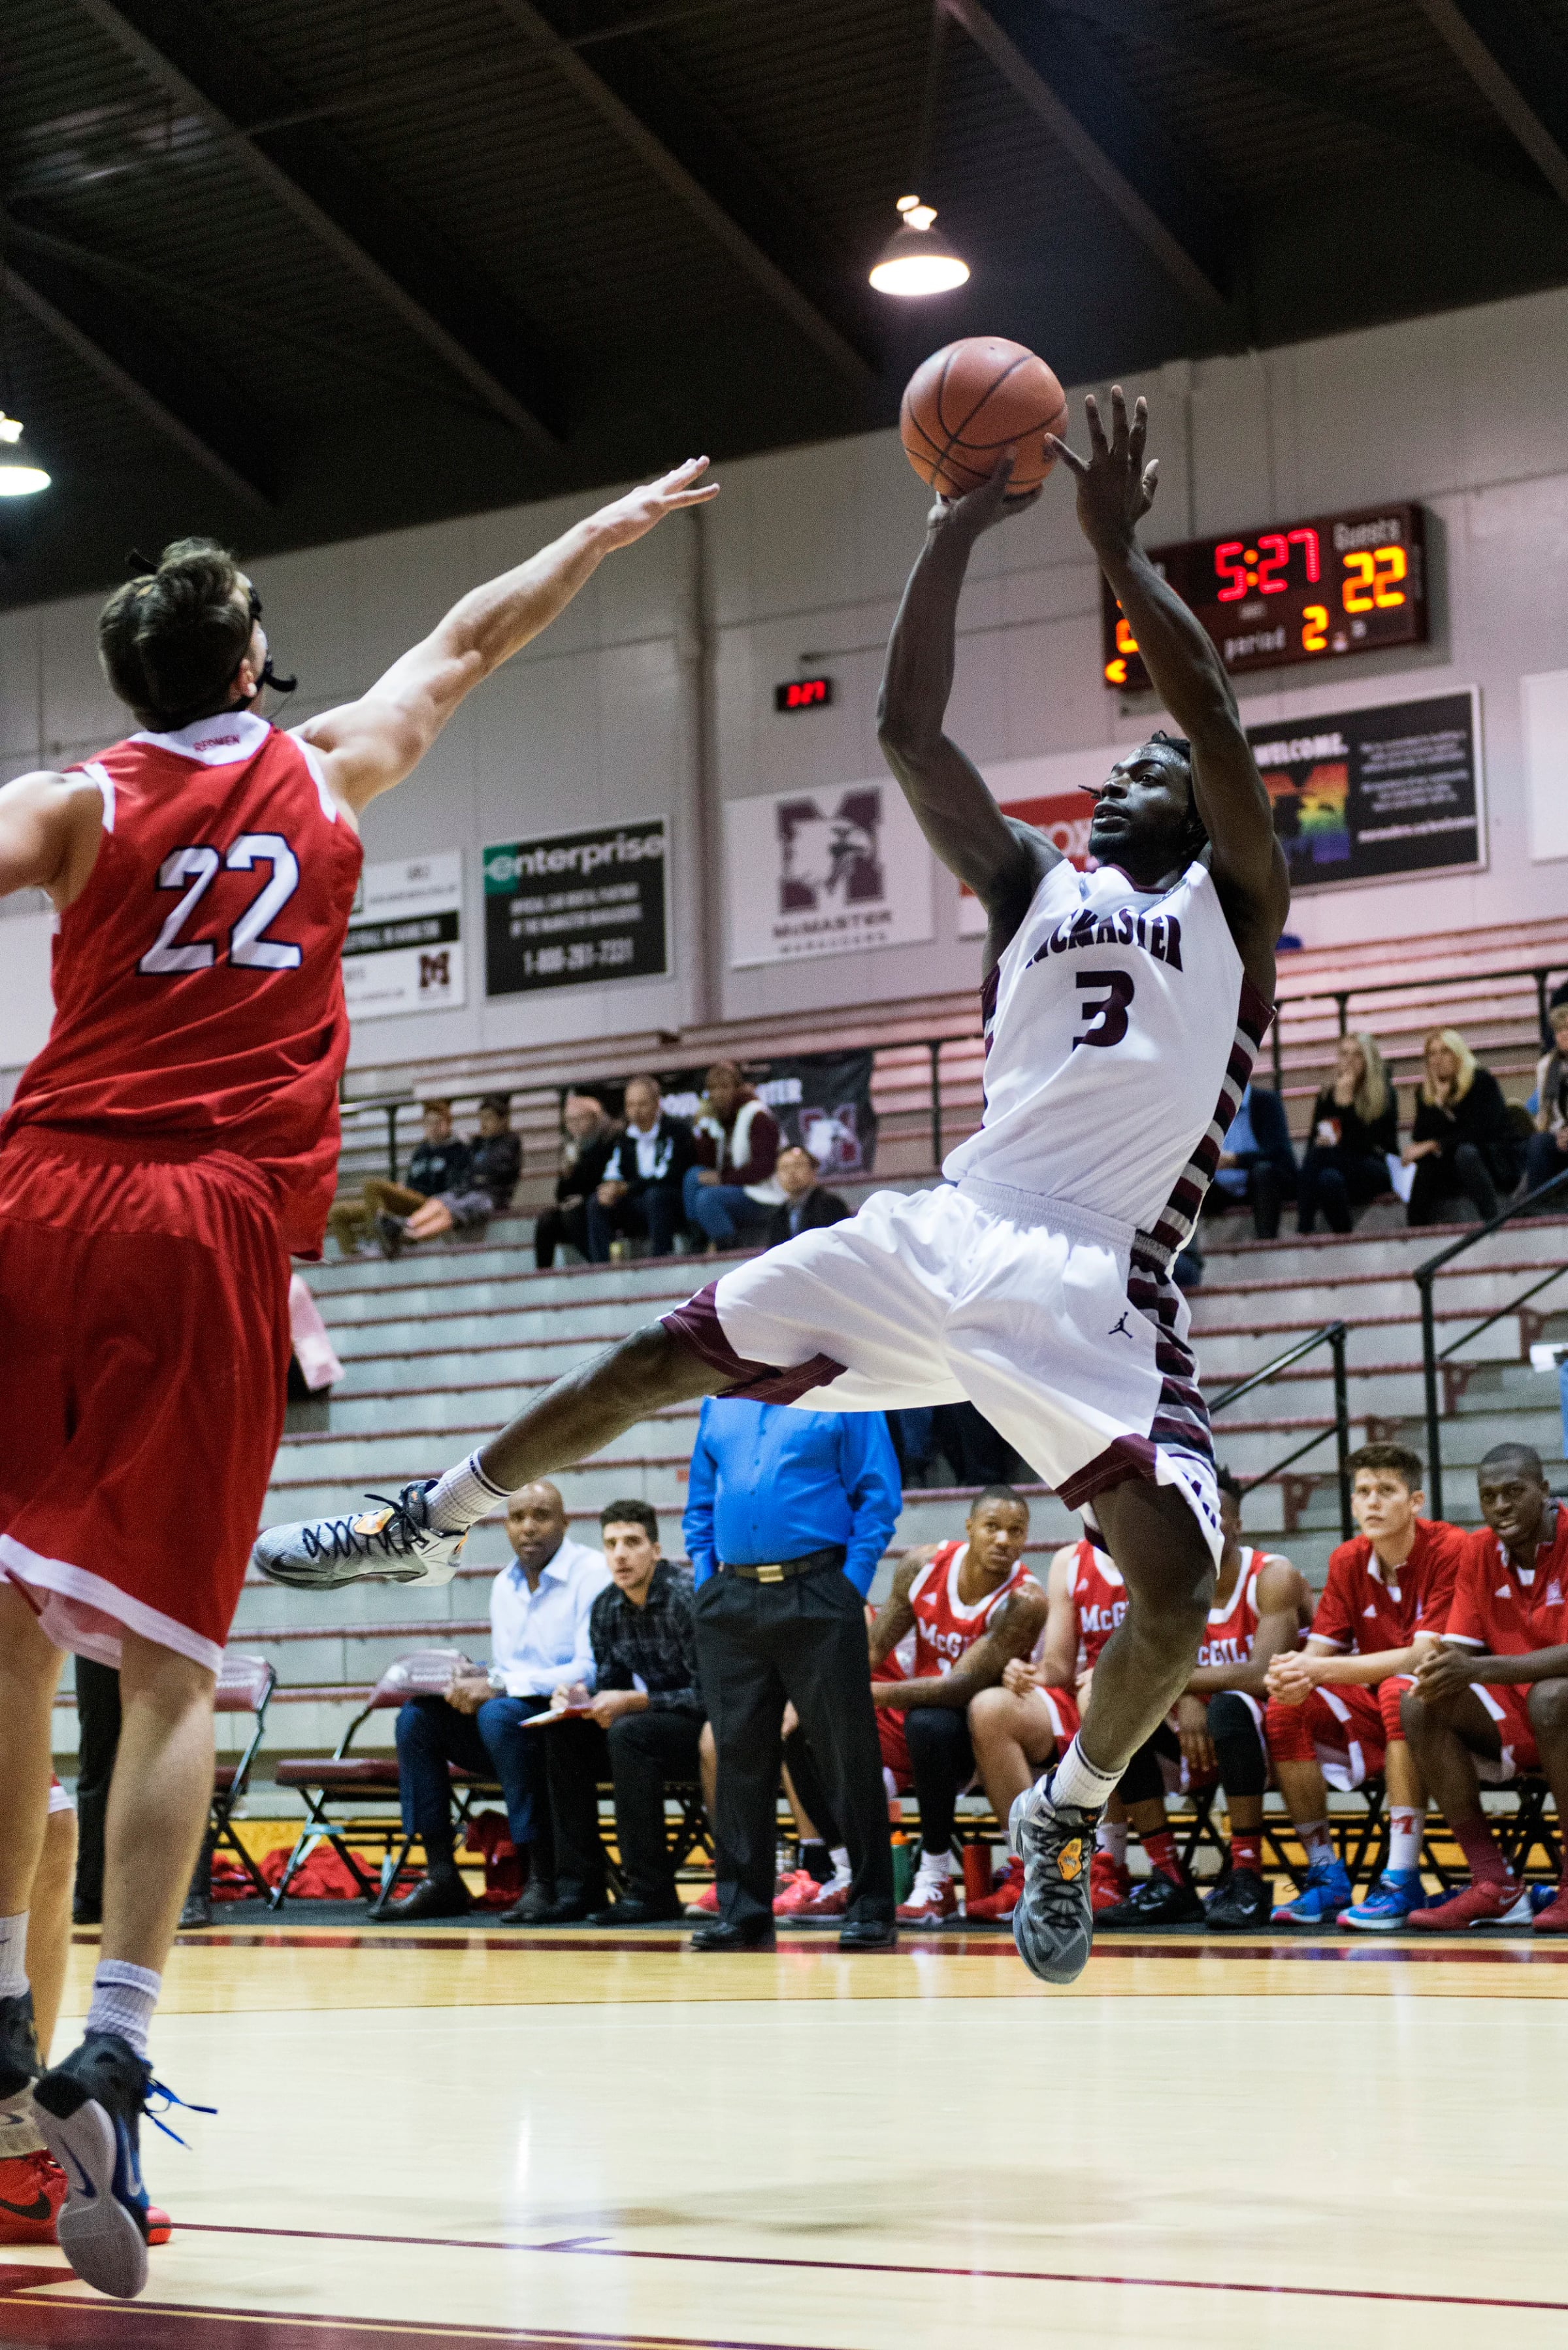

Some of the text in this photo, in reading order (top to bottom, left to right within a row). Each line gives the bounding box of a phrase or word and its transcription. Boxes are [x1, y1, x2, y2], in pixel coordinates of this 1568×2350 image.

[1214, 527, 1320, 602] 5:27
[1342, 545, 1407, 613] 22
[1302, 604, 1329, 651] 2
[484, 832, 663, 881] enterprise
[135, 831, 303, 976] 22
[1072, 969, 1135, 1053] 3
[1080, 1600, 1130, 1633] McG
